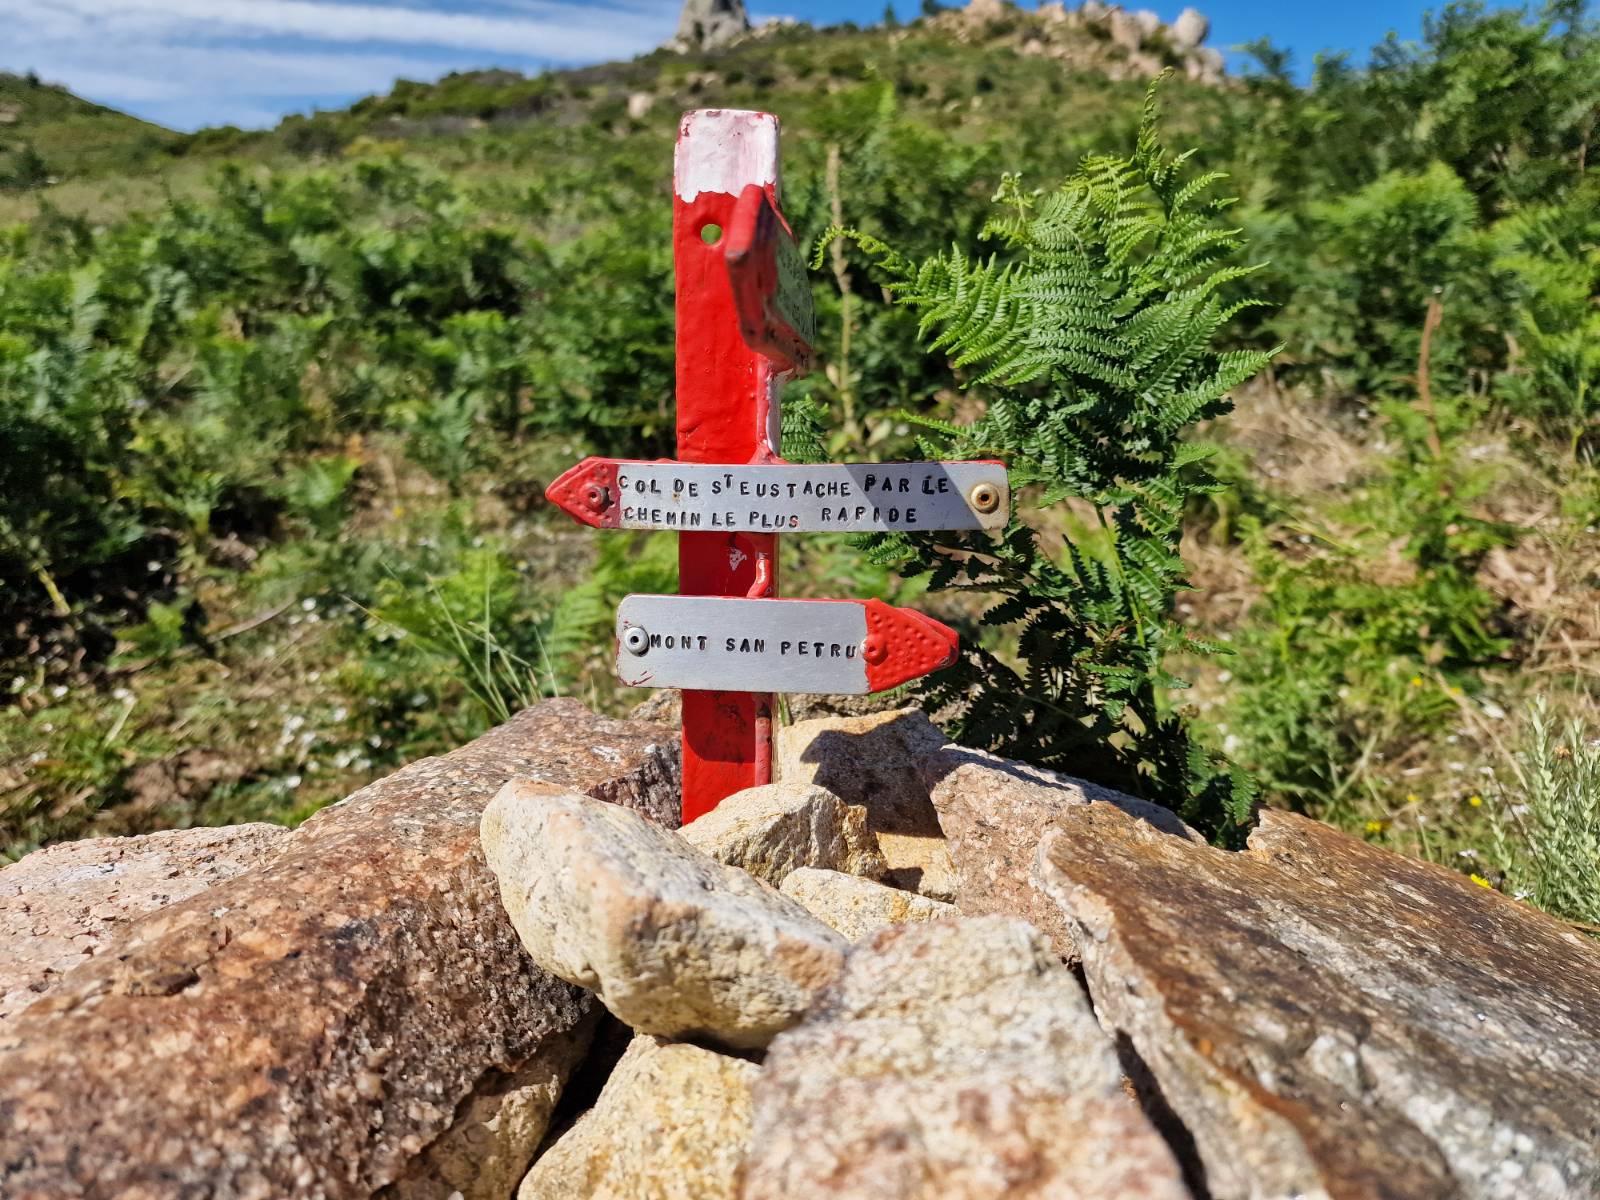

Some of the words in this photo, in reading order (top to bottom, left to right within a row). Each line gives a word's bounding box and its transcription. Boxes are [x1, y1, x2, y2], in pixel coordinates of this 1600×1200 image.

[619, 475, 662, 494] COL
[674, 478, 699, 497] DE
[864, 474, 910, 493] PAR
[921, 475, 949, 495] LE
[624, 506, 701, 527] CHEMIN
[711, 512, 736, 527] LE
[749, 511, 800, 529] PLUS
[821, 506, 918, 523] RAPIDE
[650, 634, 708, 651] MONT
[725, 638, 766, 653] SAN
[780, 641, 857, 660] PETRU
